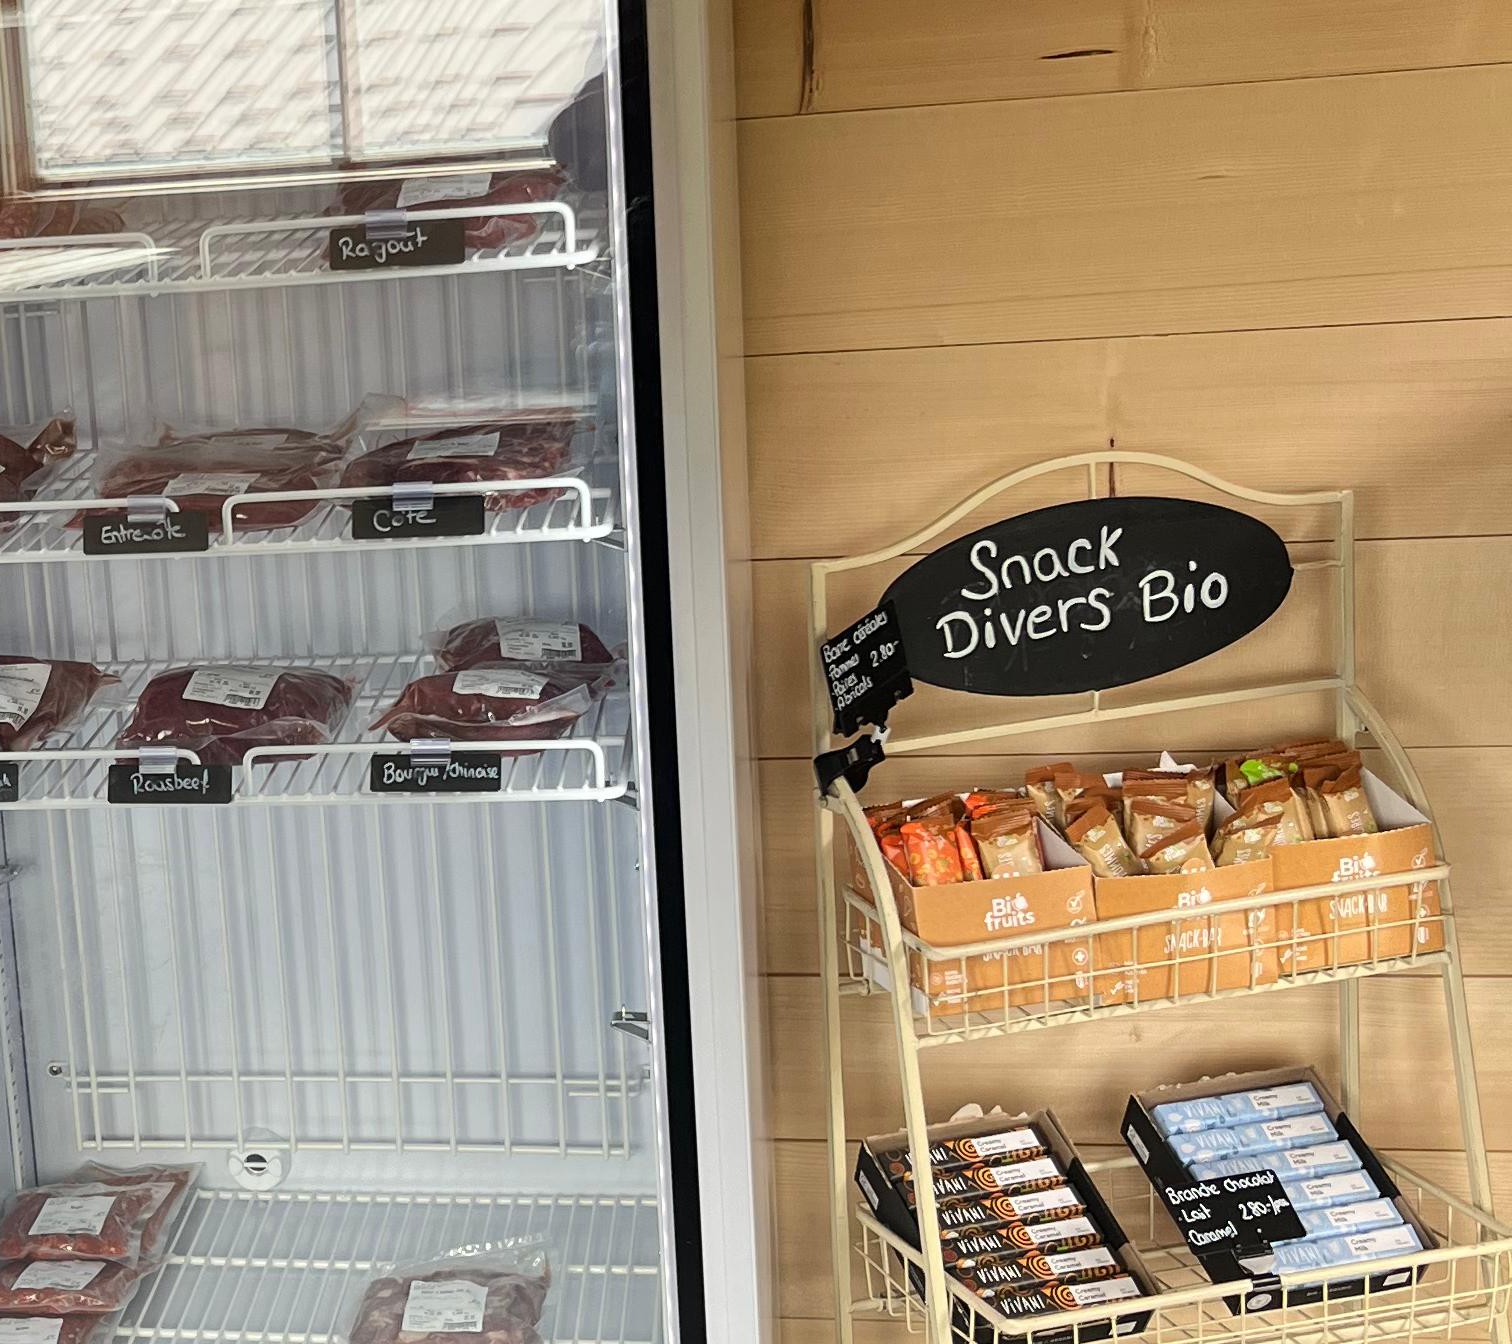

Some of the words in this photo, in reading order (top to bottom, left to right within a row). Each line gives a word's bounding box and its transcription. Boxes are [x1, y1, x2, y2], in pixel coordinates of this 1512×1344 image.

[960, 525, 1124, 601] Snack
[935, 586, 1113, 660] Divers
[1138, 560, 1229, 625] Bio
[823, 638, 852, 664] Barre
[1340, 852, 1376, 875] Bio
[992, 892, 1028, 917] Bio
[984, 911, 1036, 932] fruits
[1266, 1123, 1292, 1131] Creamy
[977, 1138, 1002, 1147] Creamy
[979, 1144, 1007, 1153] Caramel
[1289, 1151, 1315, 1159] Creamy
[995, 1168, 1021, 1176] Creamy
[999, 1173, 1026, 1182] Caramel
[1307, 1182, 1332, 1190] Creamy
[1014, 1197, 1040, 1205] Creamy
[1018, 1202, 1045, 1212] Caramel
[1181, 1203, 1211, 1223] Lait
[1329, 1209, 1356, 1217] Creamy
[1031, 1226, 1056, 1234] Creamy
[1188, 1221, 1238, 1246] Caramel
[1034, 1231, 1062, 1240] Caramel
[1350, 1237, 1376, 1246] Creamy
[1050, 1256, 1077, 1265] Creamy
[1054, 1262, 1082, 1270] Caramel
[1075, 1285, 1102, 1295] Creamy
[1078, 1291, 1106, 1301] Caramel
